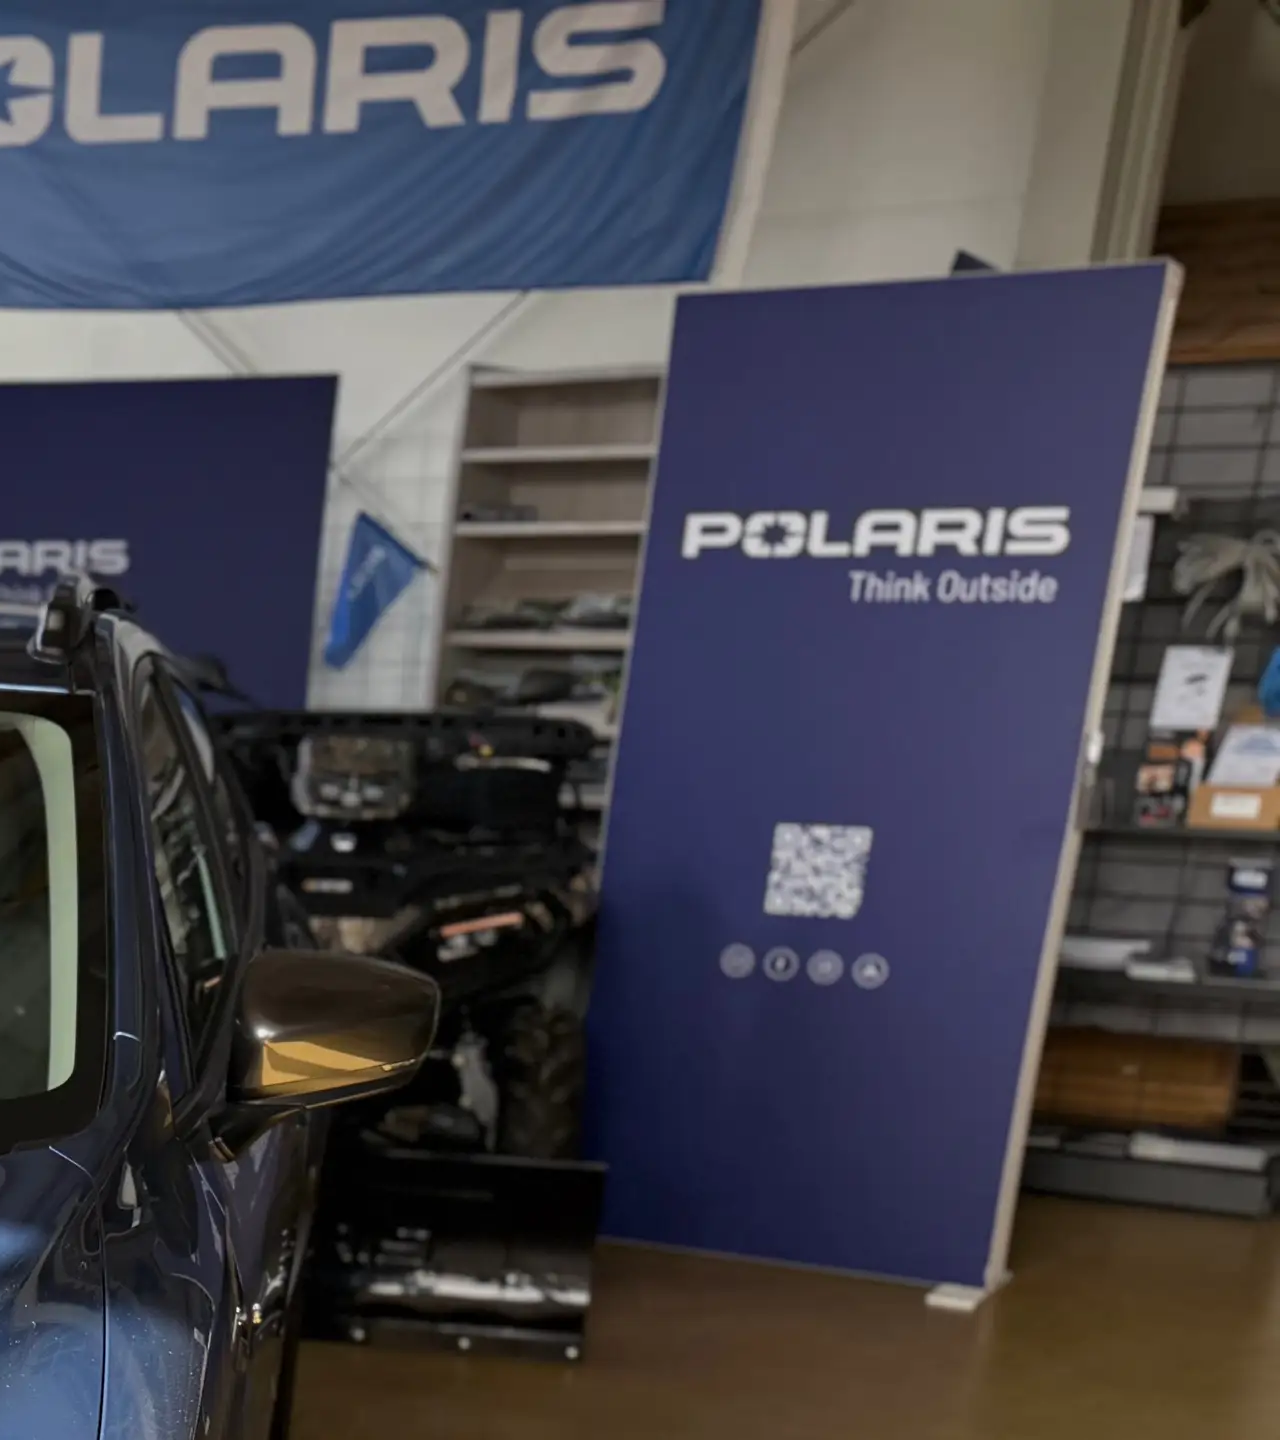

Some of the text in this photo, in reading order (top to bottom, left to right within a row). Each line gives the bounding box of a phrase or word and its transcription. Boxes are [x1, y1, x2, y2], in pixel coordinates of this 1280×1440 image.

[682, 506, 1072, 560] POLARIS
[849, 569, 1058, 604] Think Outside
